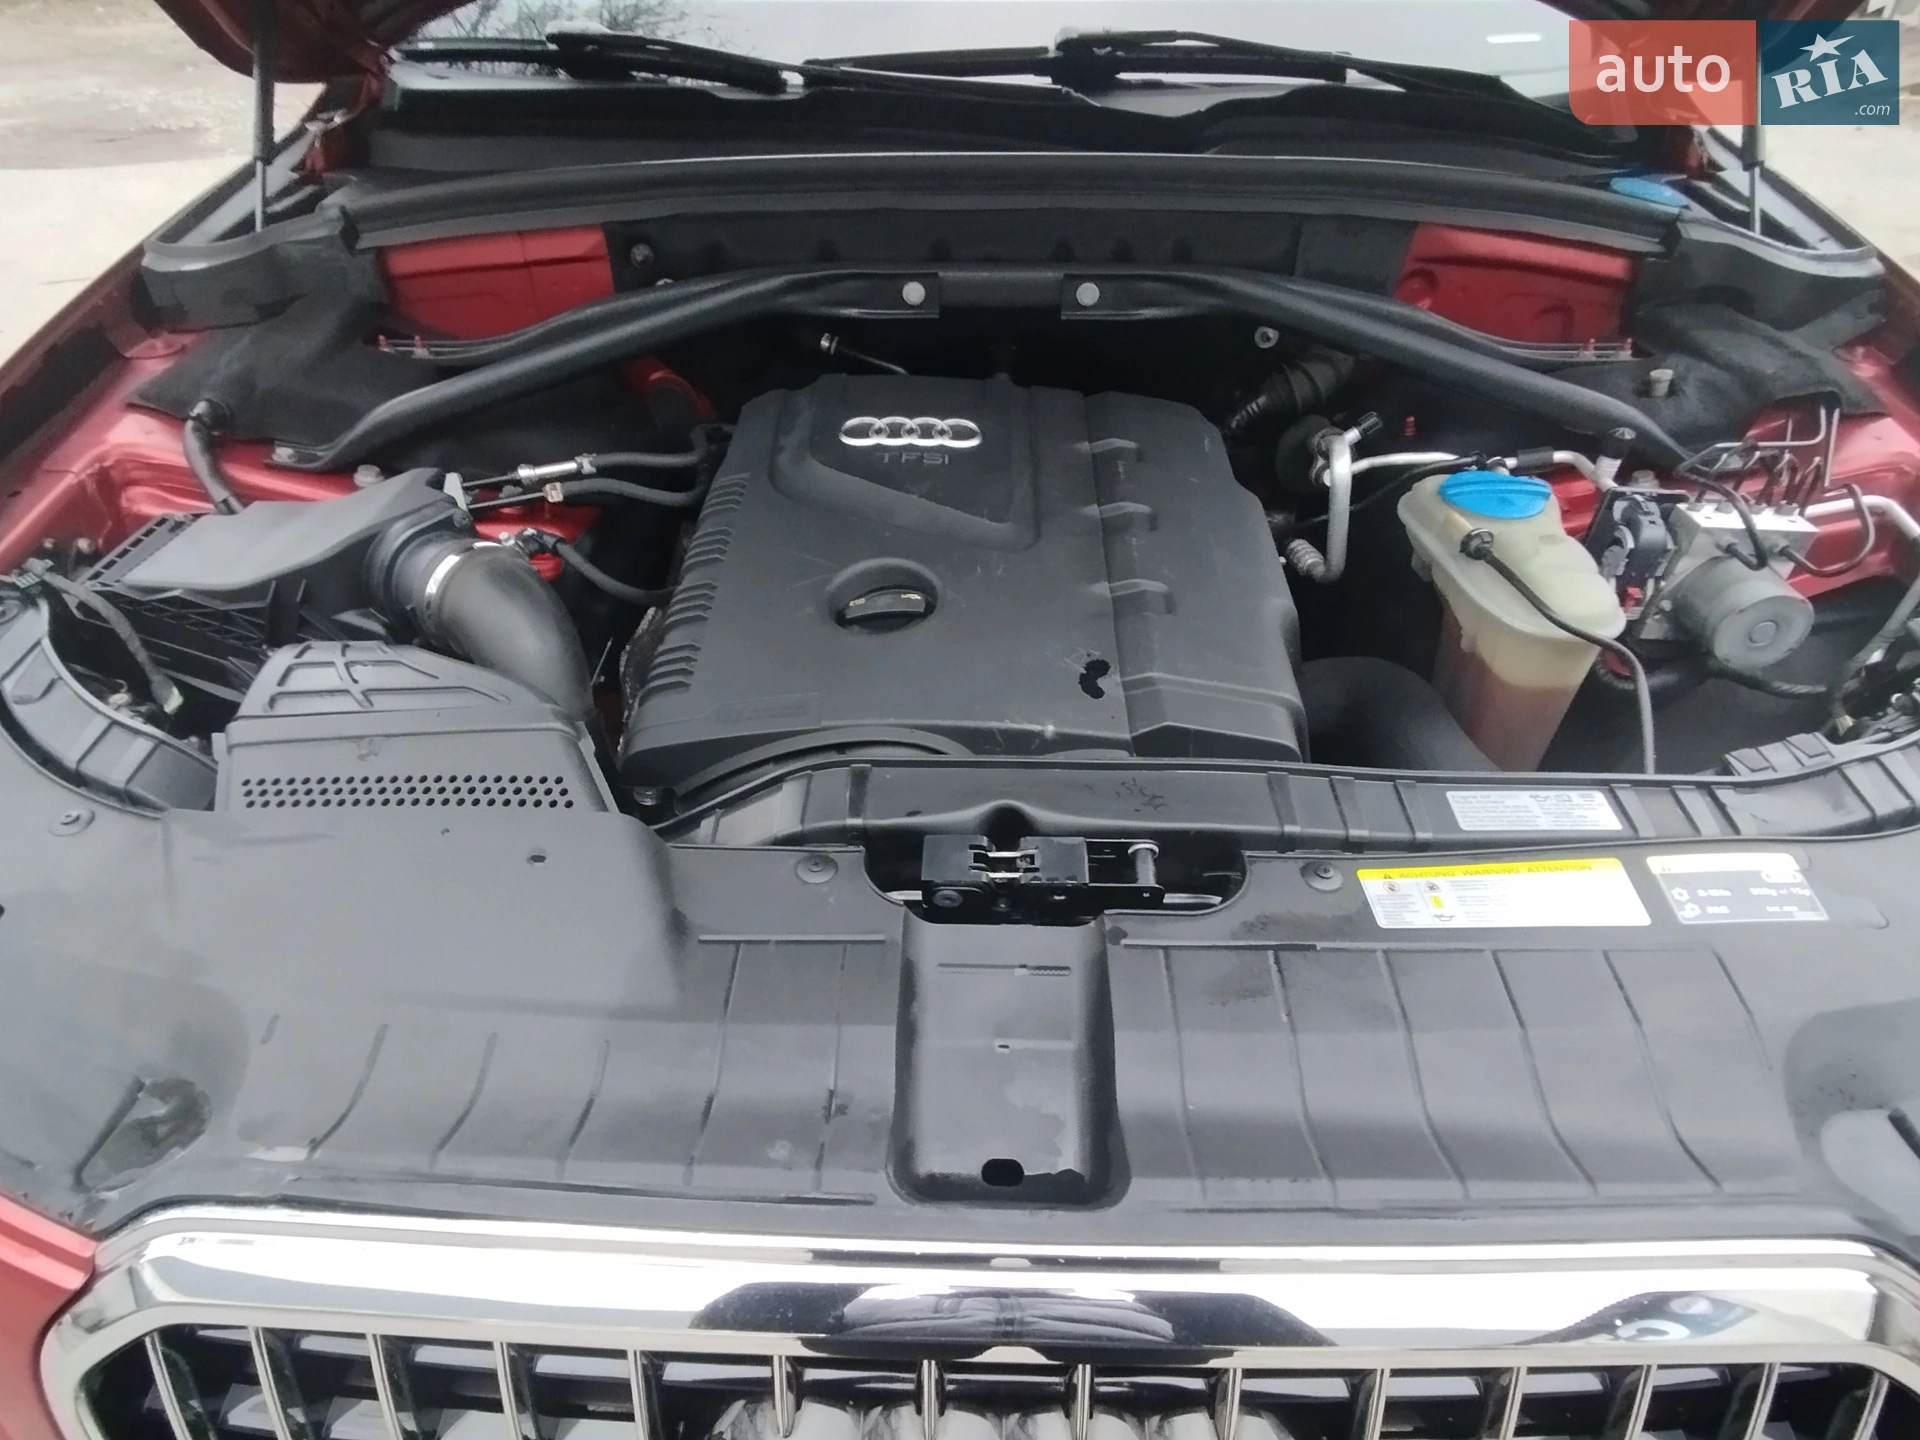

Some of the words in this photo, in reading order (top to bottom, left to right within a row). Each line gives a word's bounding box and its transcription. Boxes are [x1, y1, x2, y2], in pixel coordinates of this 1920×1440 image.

[876, 452, 949, 464] TFSI
[1400, 869, 1456, 878] ACHTUNG
[1462, 867, 1520, 876] WARNING
[1527, 865, 1592, 873] ATTENTION
